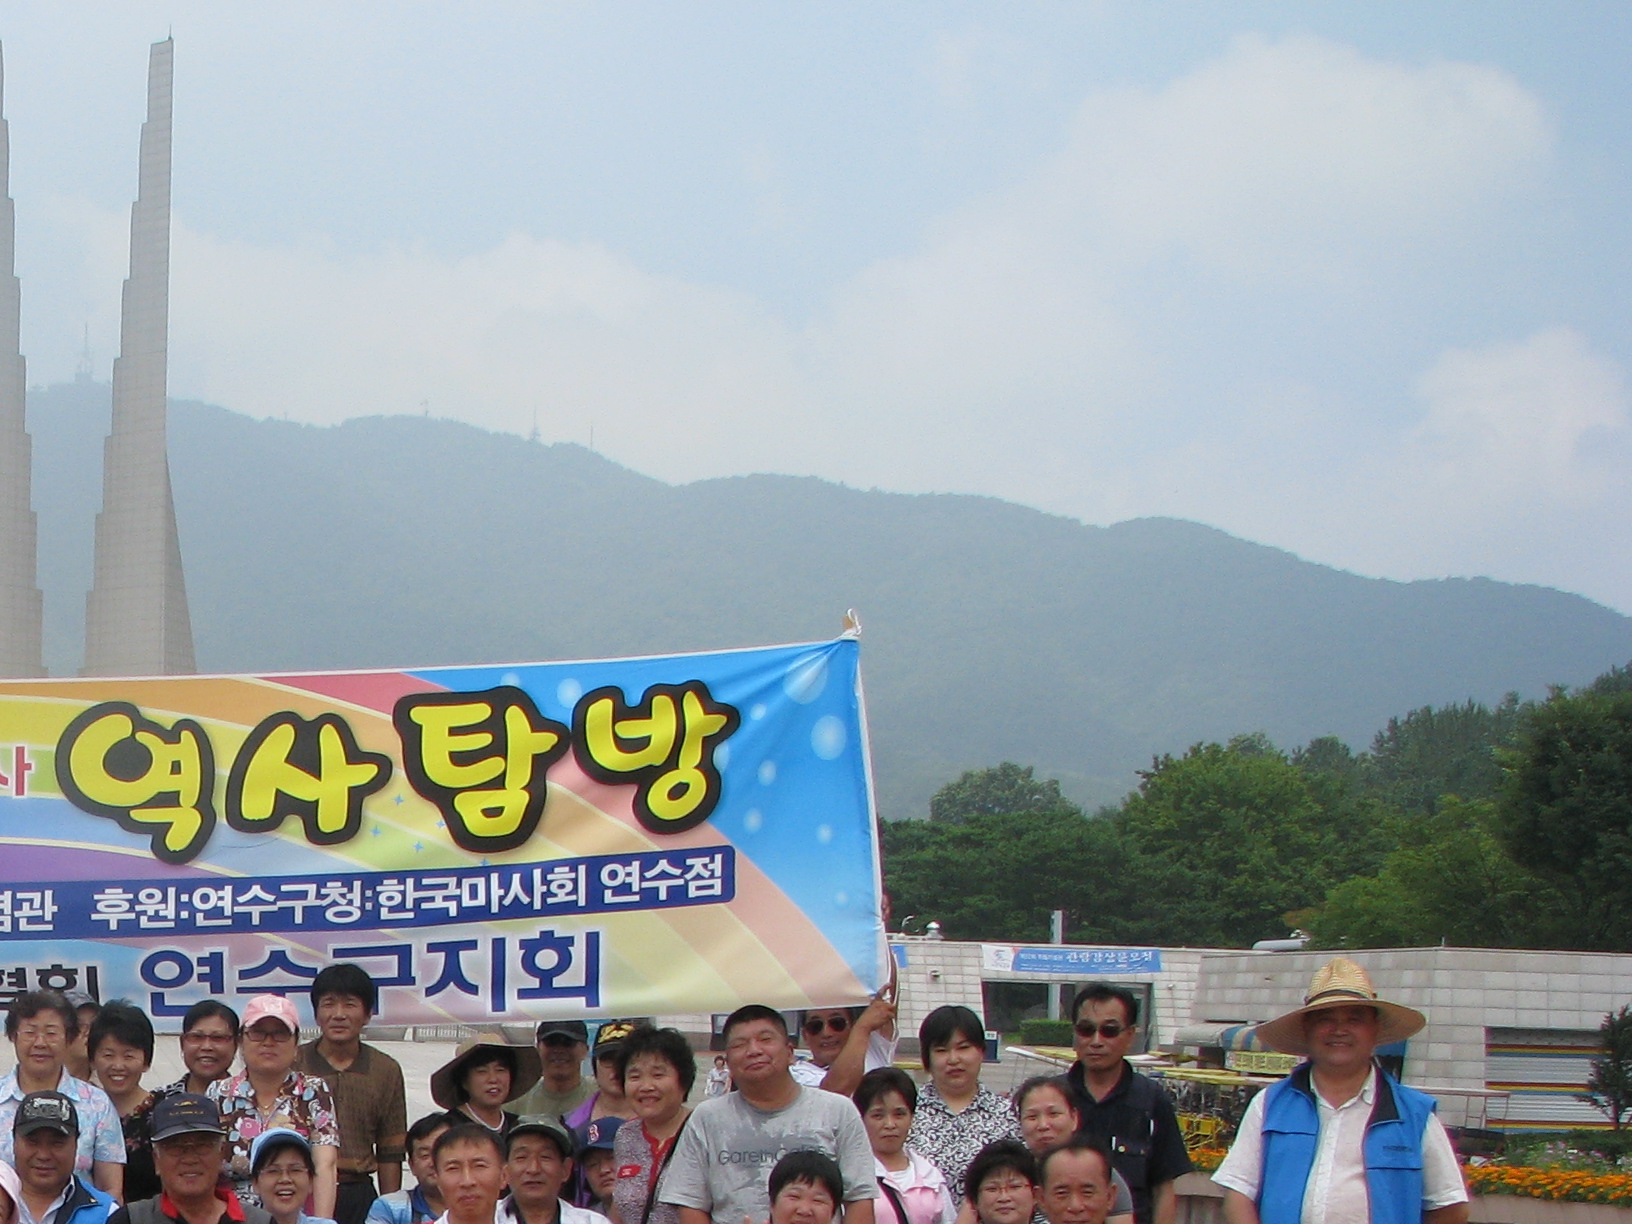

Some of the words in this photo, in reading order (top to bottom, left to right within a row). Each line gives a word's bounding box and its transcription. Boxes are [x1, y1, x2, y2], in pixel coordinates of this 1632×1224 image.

[58, 684, 737, 860] 역사탐방
[90, 864, 587, 931] 후원:연수구청:한국마사회
[599, 852, 724, 905] 연수점
[139, 929, 600, 1018] 연수구지회
